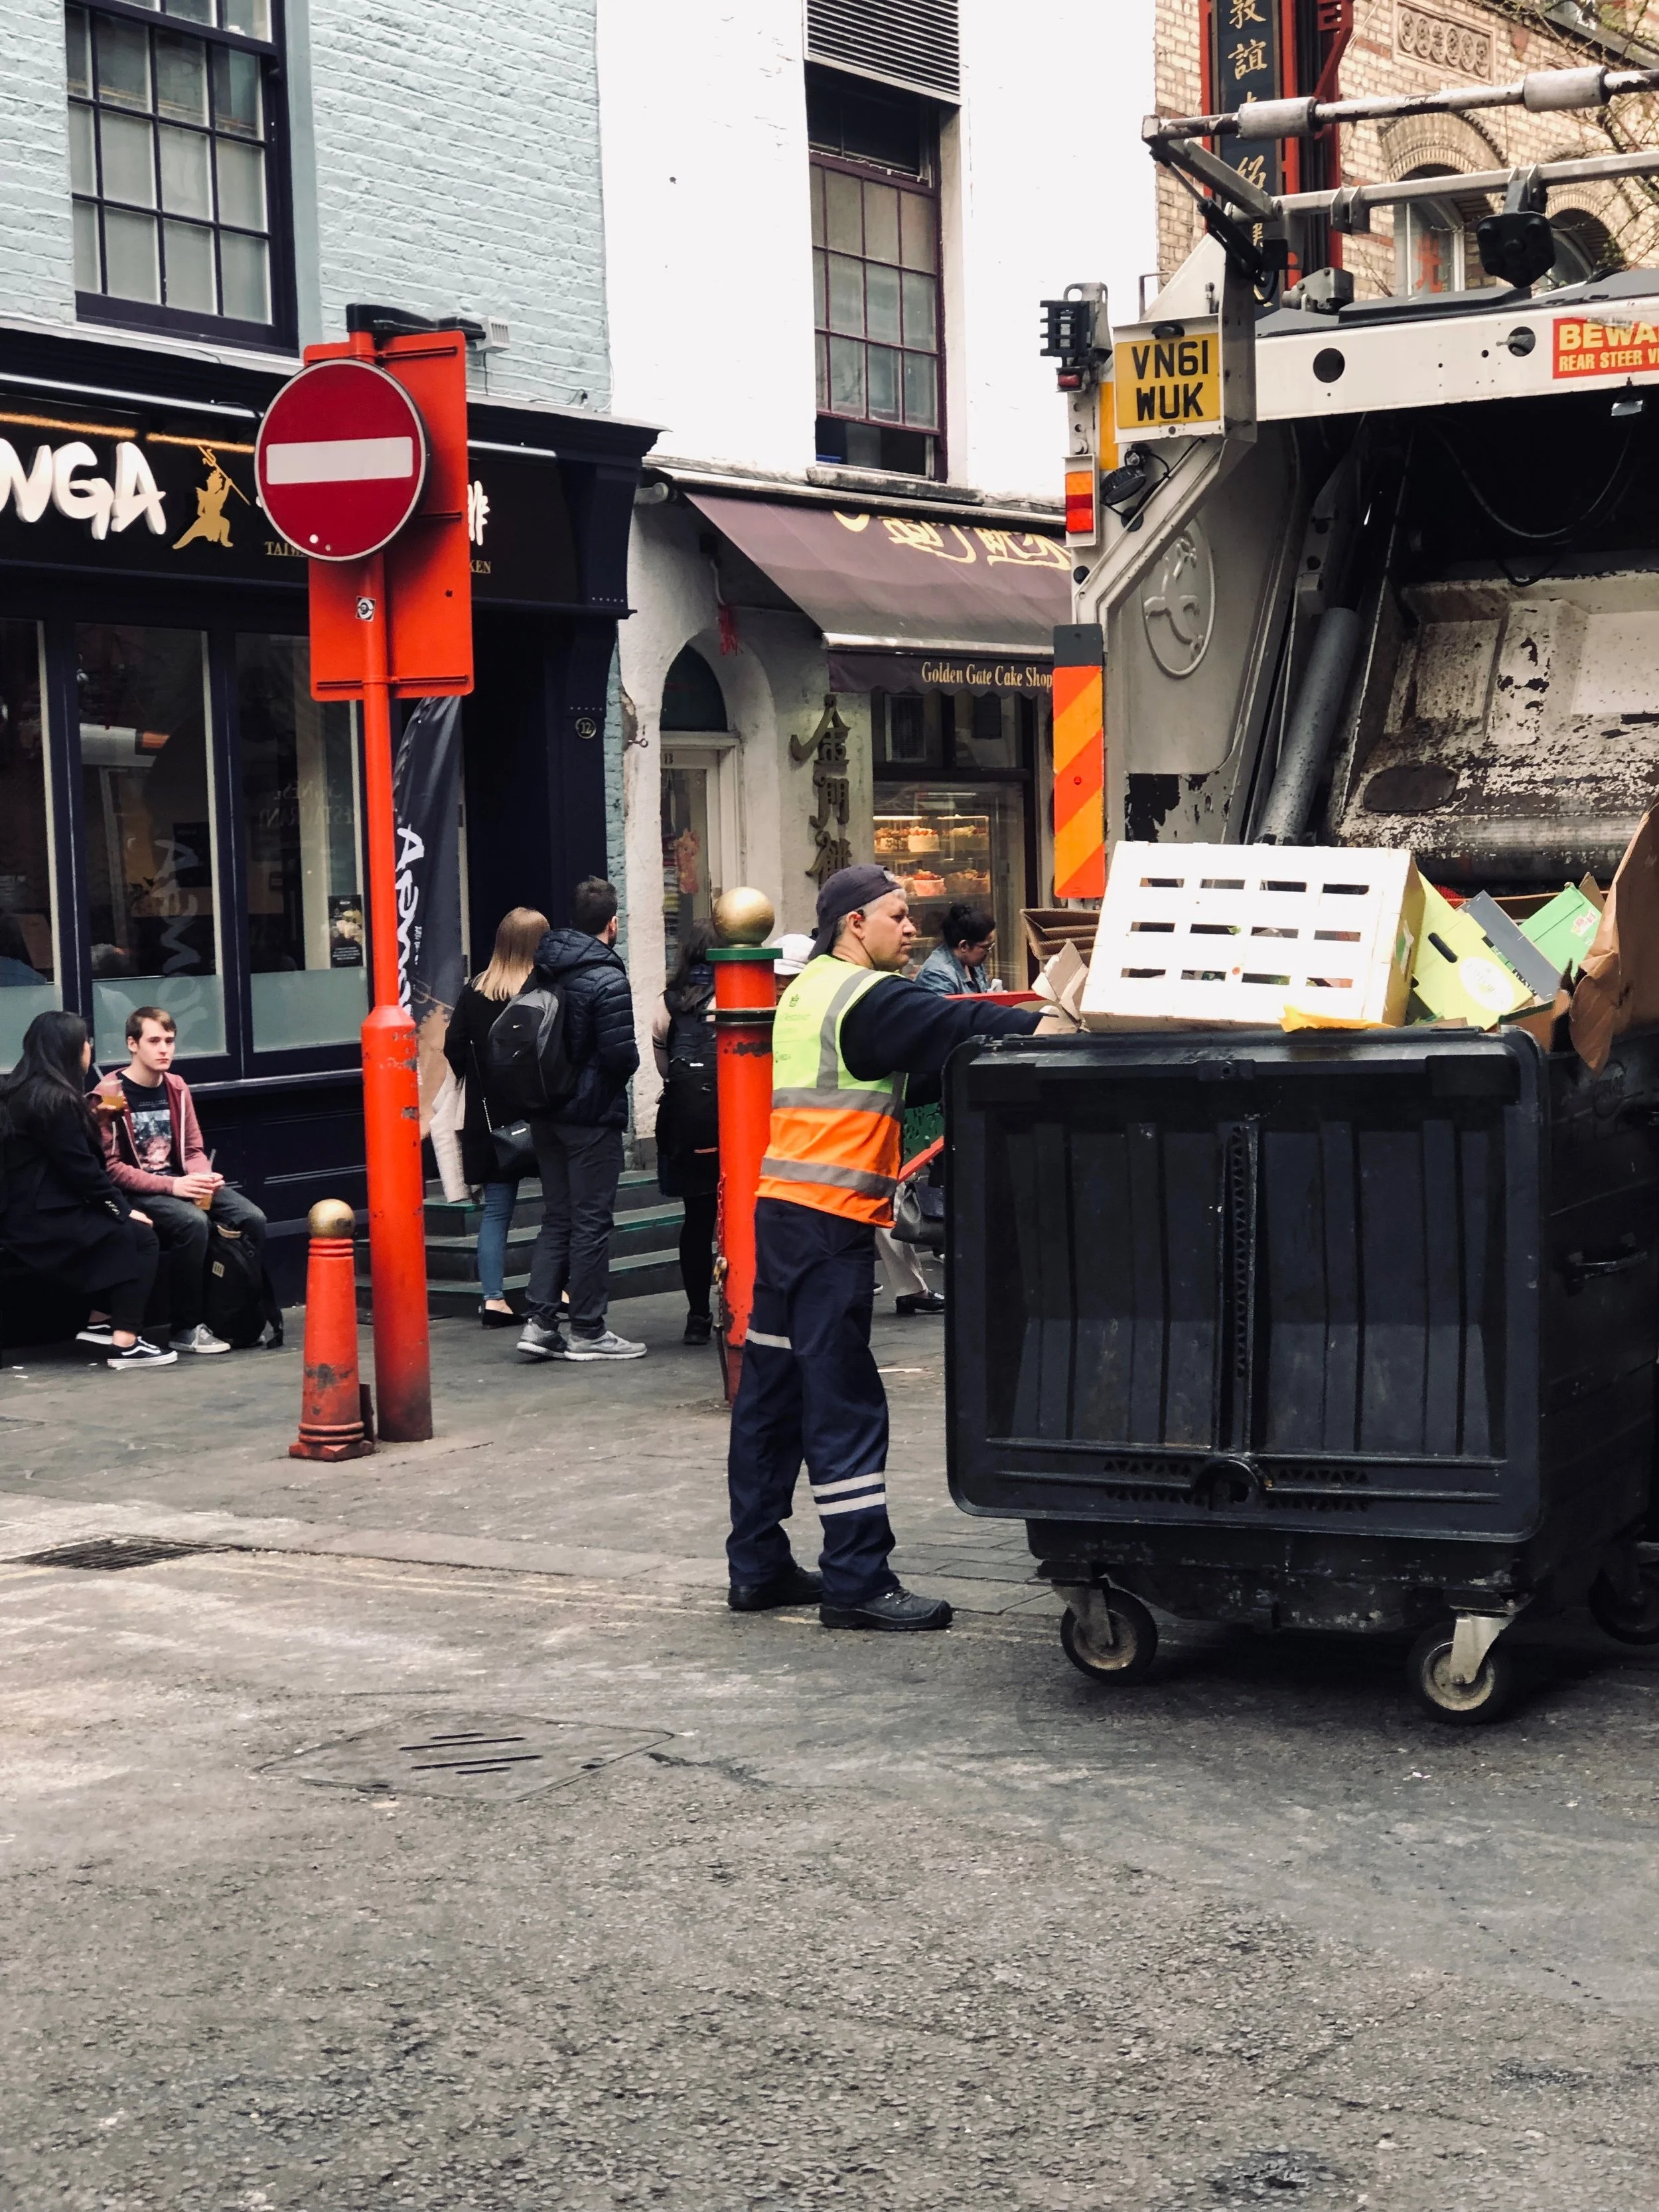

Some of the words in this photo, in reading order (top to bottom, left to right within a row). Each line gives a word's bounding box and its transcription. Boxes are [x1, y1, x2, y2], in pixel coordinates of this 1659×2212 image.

[1559, 322, 1659, 351] BEWA
[1131, 340, 1208, 380] VN61
[1559, 353, 1595, 372] REAR
[1599, 349, 1643, 368] STEER
[1136, 382, 1204, 421] WUK
[921, 661, 963, 684] Golden
[966, 664, 993, 685] Gate
[995, 666, 1023, 687] Cake
[1025, 666, 1052, 693] Shop
